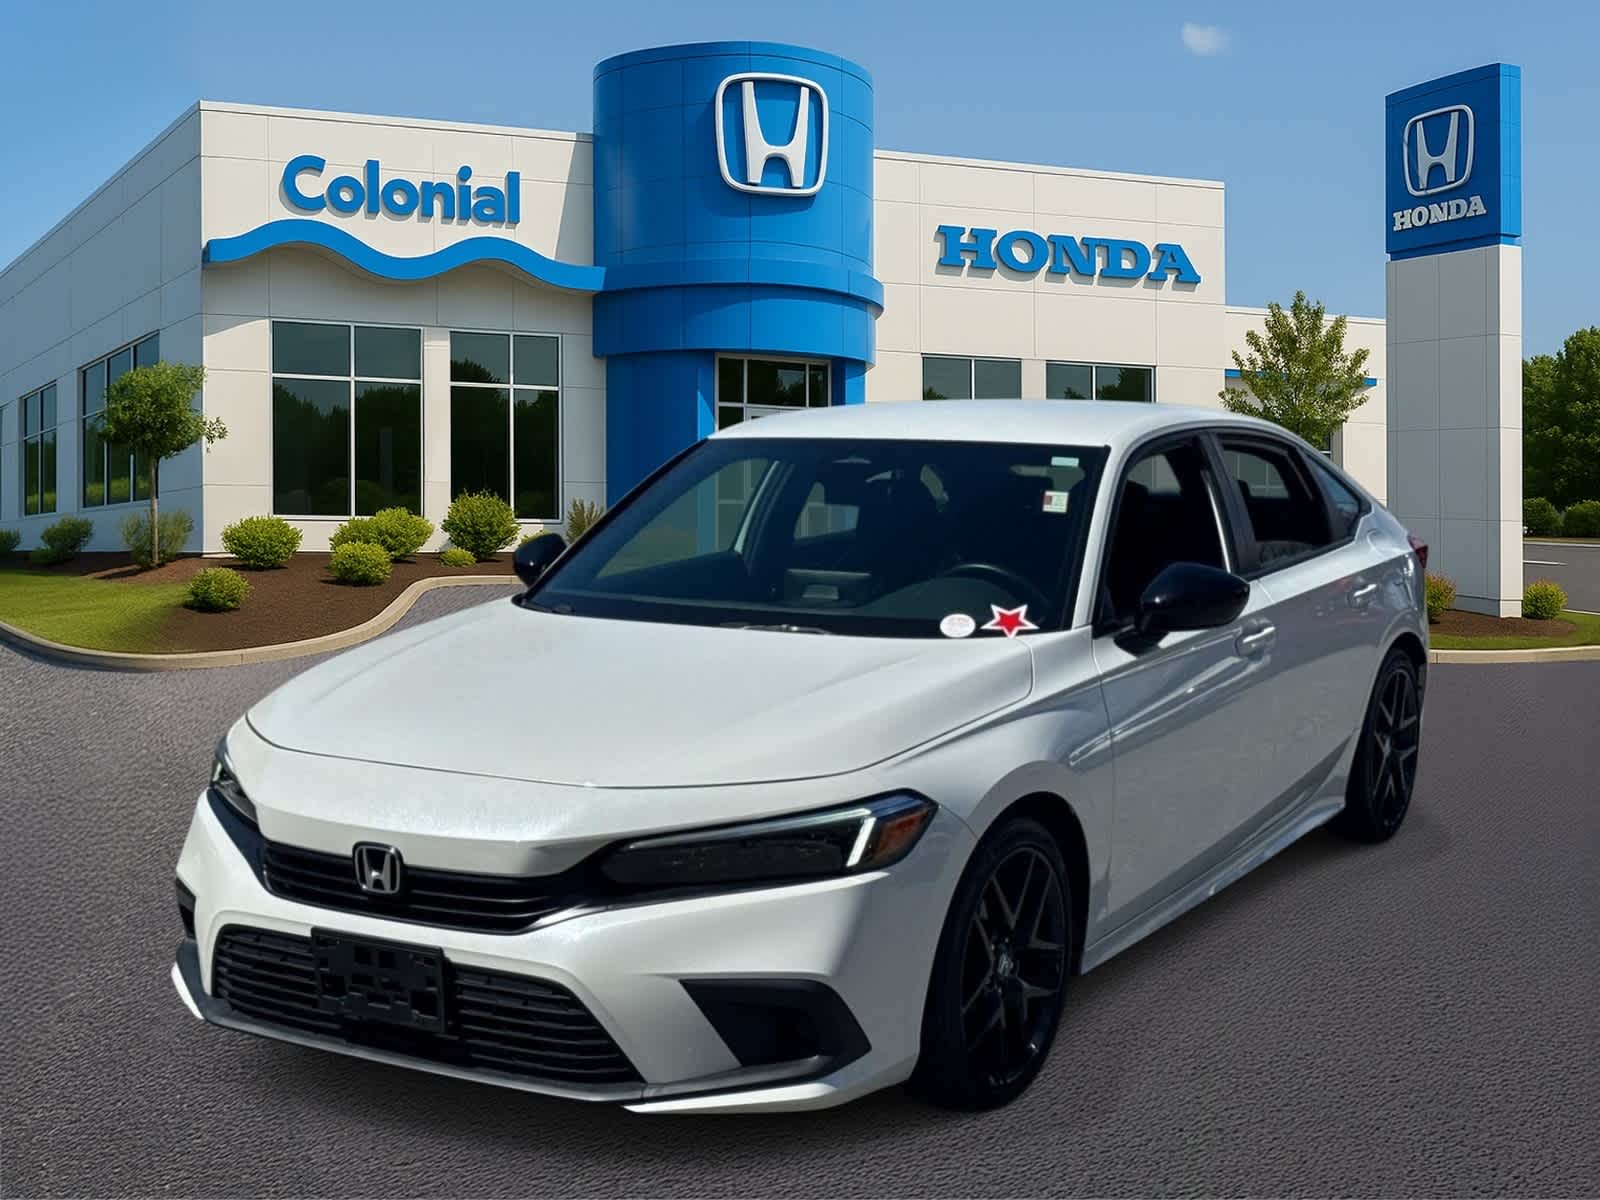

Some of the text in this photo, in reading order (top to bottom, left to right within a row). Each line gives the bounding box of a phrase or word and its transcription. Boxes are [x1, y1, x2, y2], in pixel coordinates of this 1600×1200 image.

[282, 156, 521, 224] Colonial
[1393, 195, 1486, 230] HONDA
[937, 225, 1201, 284] HONDA
